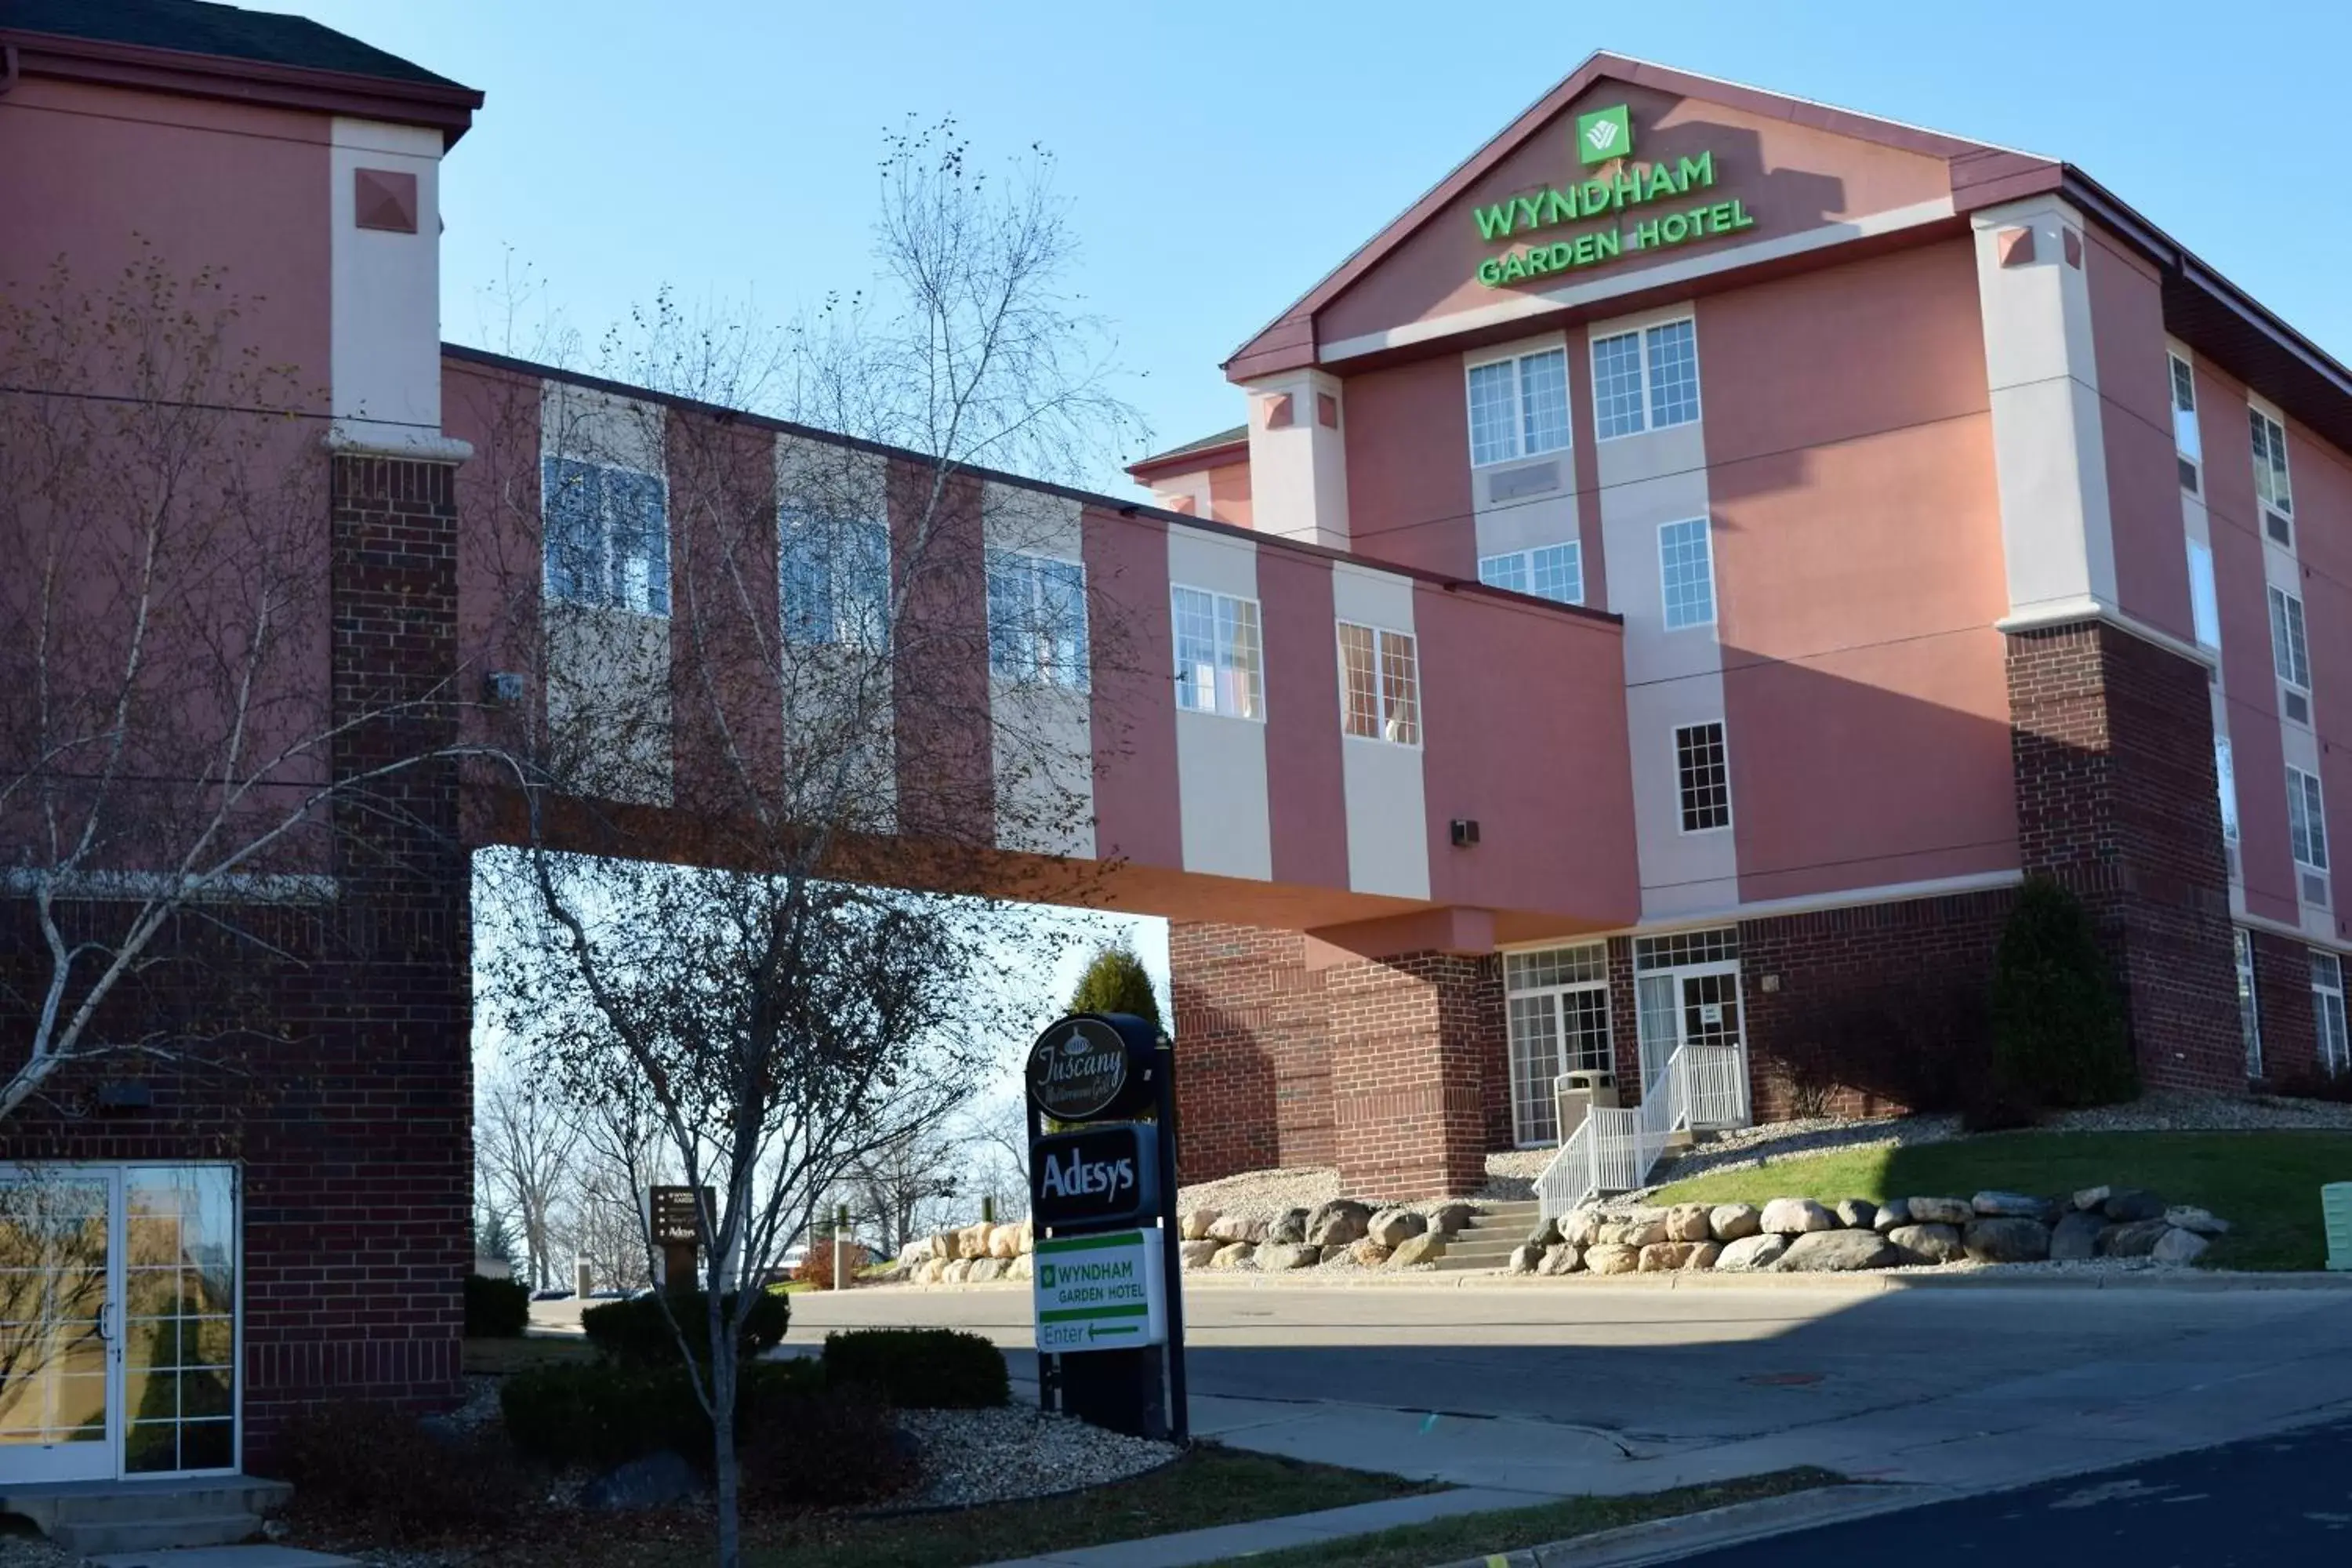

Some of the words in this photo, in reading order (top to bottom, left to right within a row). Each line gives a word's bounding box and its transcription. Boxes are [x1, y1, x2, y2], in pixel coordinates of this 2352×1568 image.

[1473, 150, 1715, 241] WYNDHAM
[1478, 228, 1621, 289] GARDEN
[1636, 199, 1754, 250] HOTEL
[1036, 1045, 1122, 1087] Tuscany
[1059, 1261, 1132, 1283] WYNDHAM
[1059, 1287, 1104, 1303] GARDEN
[1109, 1284, 1144, 1298] HOTEL
[1044, 1325, 1084, 1345] Enter
